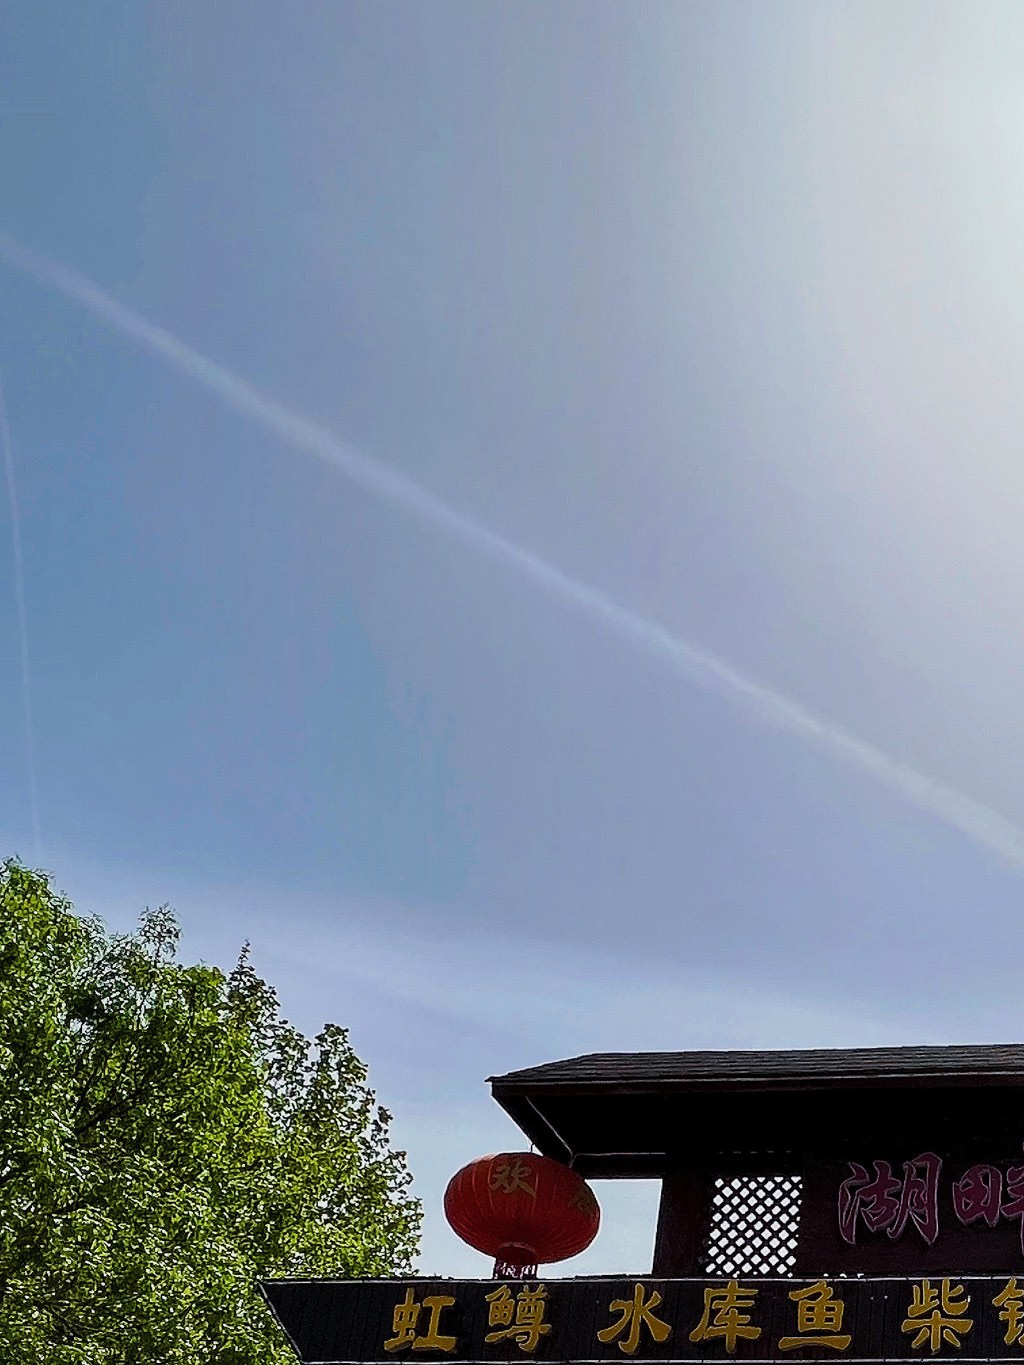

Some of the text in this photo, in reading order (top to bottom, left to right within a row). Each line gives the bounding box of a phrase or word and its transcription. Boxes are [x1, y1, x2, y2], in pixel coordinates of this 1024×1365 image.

[488, 1157, 537, 1198] 欢
[383, 1283, 552, 1353] 虹鳟
[598, 1280, 853, 1354] 水库鱼
